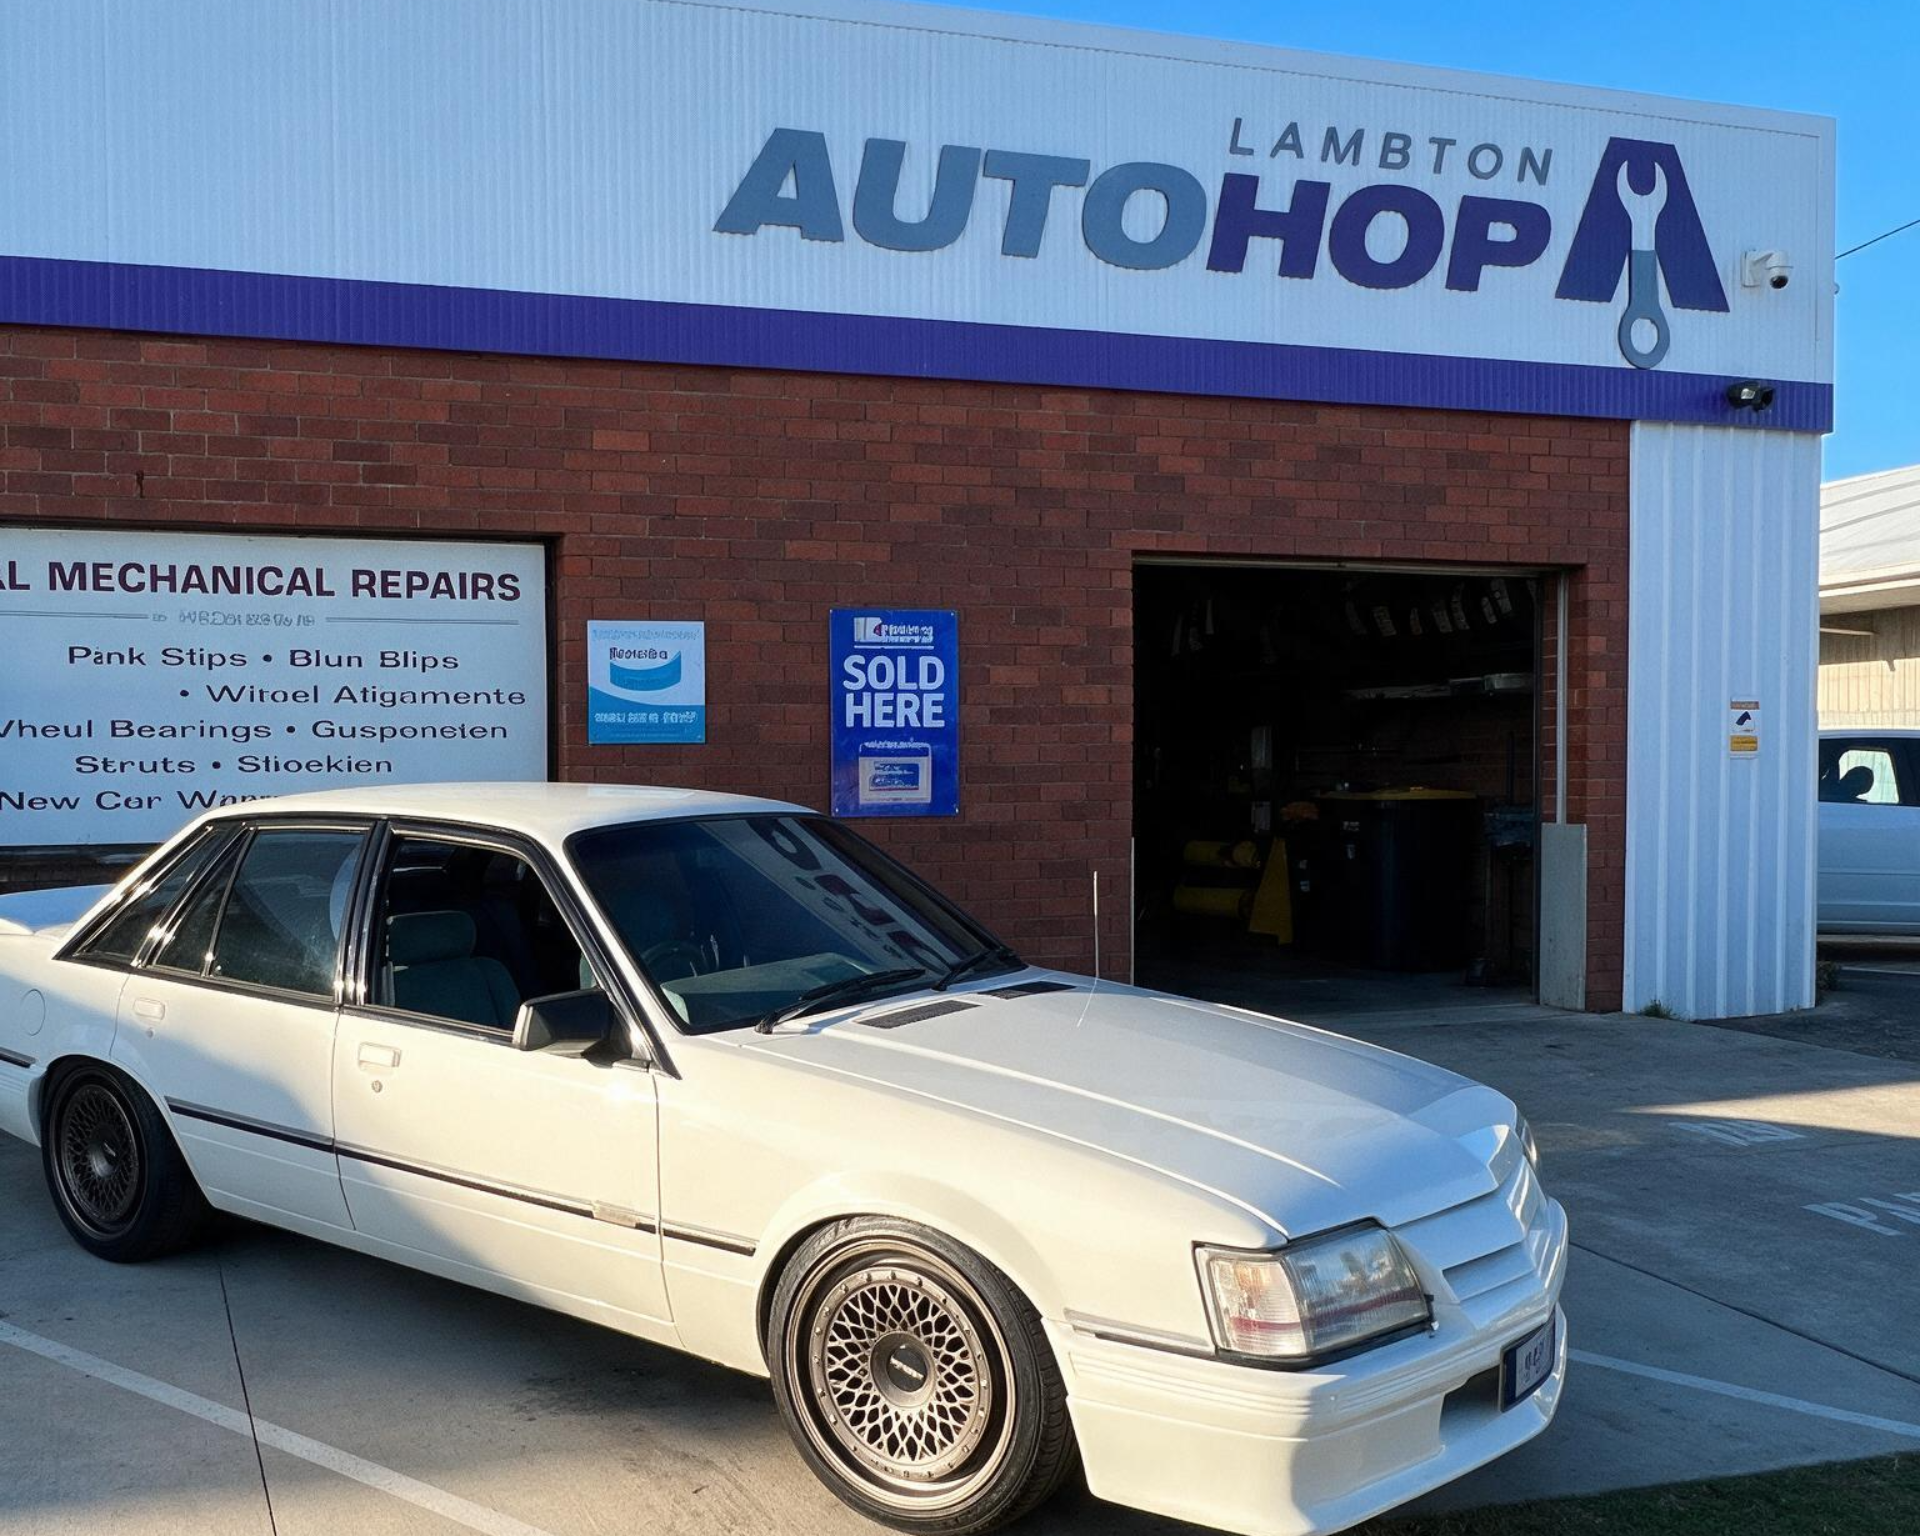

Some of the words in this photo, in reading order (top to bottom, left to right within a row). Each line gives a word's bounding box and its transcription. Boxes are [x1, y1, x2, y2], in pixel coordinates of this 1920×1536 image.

[1229, 117, 1553, 186] LAMBTON
[0, 560, 31, 591] L
[48, 561, 336, 597] MECHANICAL
[351, 569, 521, 602] REPAIRS
[161, 647, 248, 671] Stips
[289, 649, 363, 668] Blun
[379, 650, 459, 673] Blips
[843, 654, 945, 691] SOLD
[845, 691, 946, 728] HERE
[110, 719, 272, 743] Bearings
[75, 755, 196, 774] Struts
[0, 791, 81, 811] New
